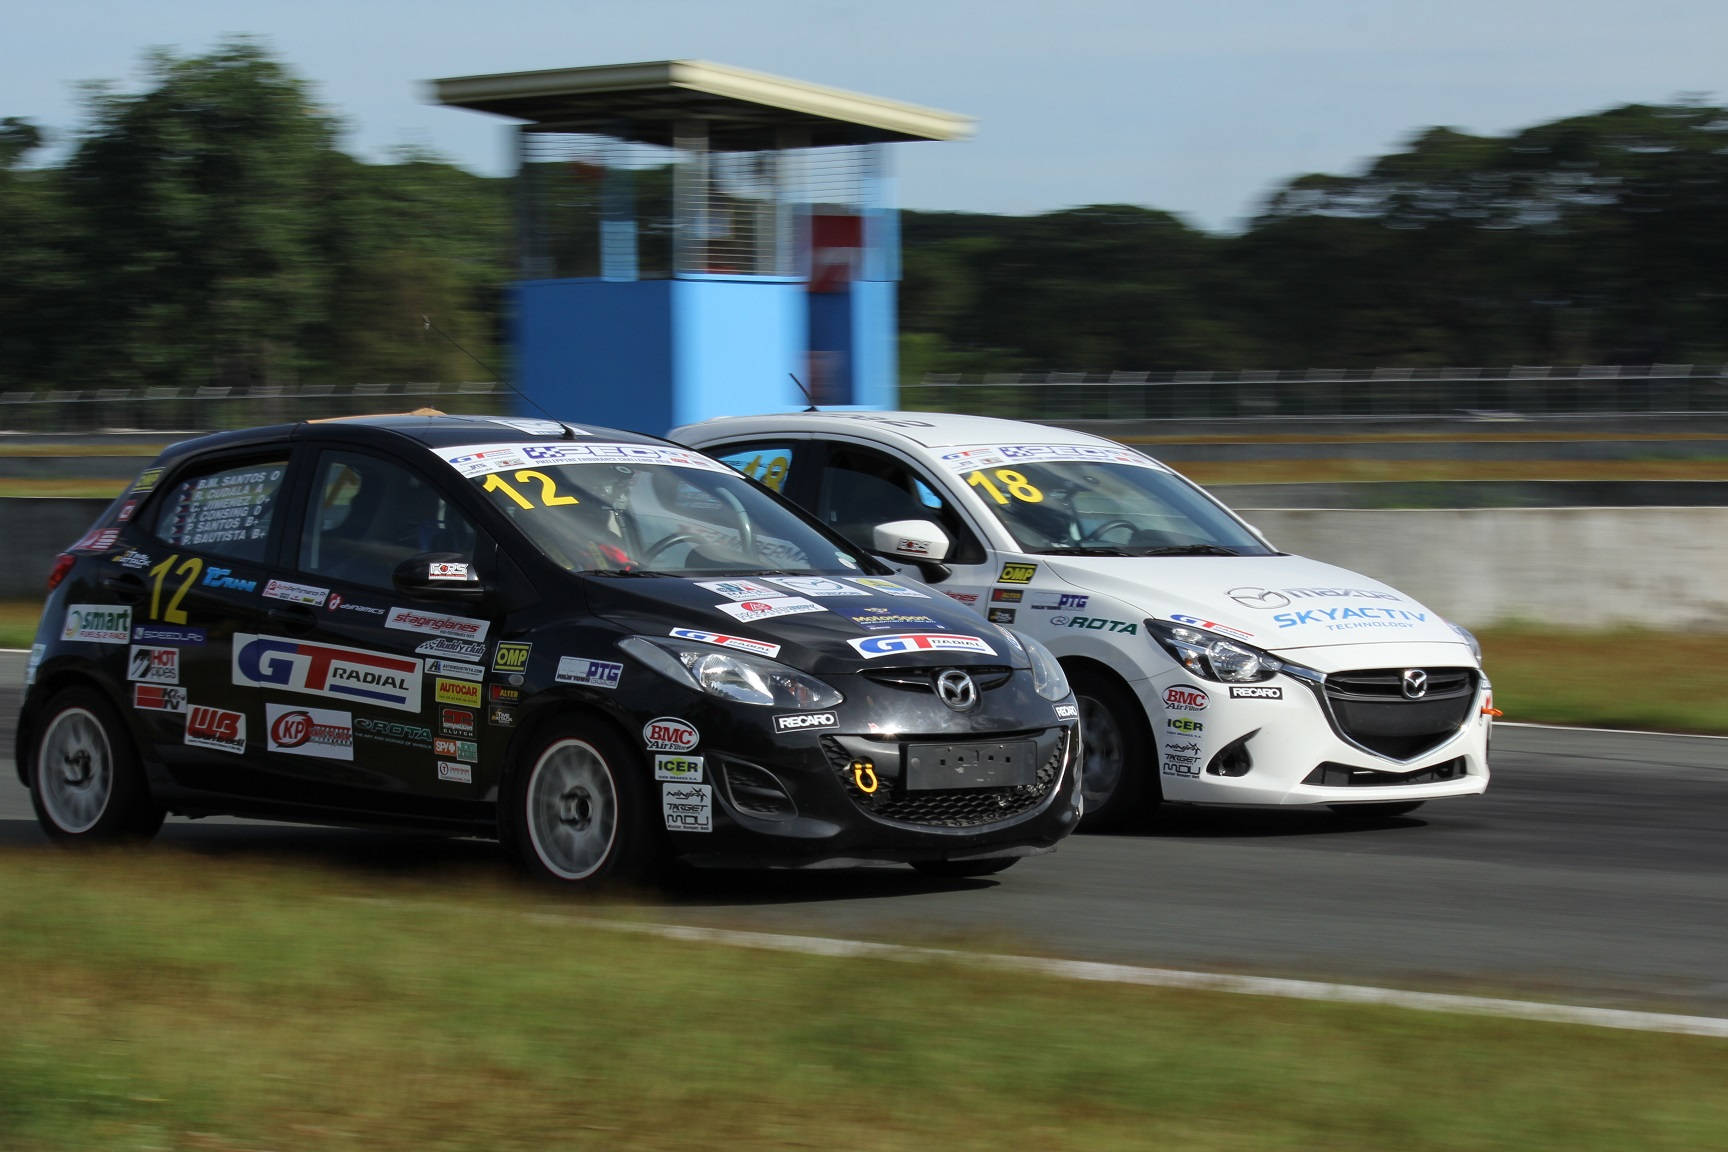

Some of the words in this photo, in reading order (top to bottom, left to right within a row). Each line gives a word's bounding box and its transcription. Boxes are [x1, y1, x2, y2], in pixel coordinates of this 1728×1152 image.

[221, 471, 268, 485] SANTOS
[966, 469, 1044, 505] 18
[482, 470, 580, 510] 12
[197, 518, 241, 532] SANTOS
[193, 529, 247, 544] BAUTISTA
[1001, 567, 1034, 581] OMP
[148, 554, 204, 625] 12
[1058, 594, 1089, 608] PTG
[81, 609, 129, 632] smart
[392, 611, 482, 633] staginglanes
[1068, 616, 1138, 635] ROTA
[1273, 607, 1427, 628] SKYACTIV
[1326, 621, 1416, 632] TECHNOLOGY
[674, 629, 778, 649] GT
[859, 635, 979, 653] GT
[931, 639, 984, 648] RADIAL
[150, 649, 178, 667] HOT
[238, 639, 417, 690] GT
[331, 666, 410, 692] RADIAL
[496, 649, 528, 666] OMP
[588, 662, 622, 682] PTG
[439, 682, 478, 698] AUTOCAR
[1167, 689, 1206, 707] BMC
[1233, 687, 1281, 698] RECARO
[1166, 702, 1183, 711] Air
[282, 719, 306, 740] KP
[778, 712, 836, 729] RECARO
[1167, 719, 1203, 731] ICER
[371, 720, 432, 743] ROTA
[649, 724, 694, 745] BMC
[648, 740, 668, 751] Air
[658, 759, 698, 773] ICER
[667, 803, 708, 812] TARGET
